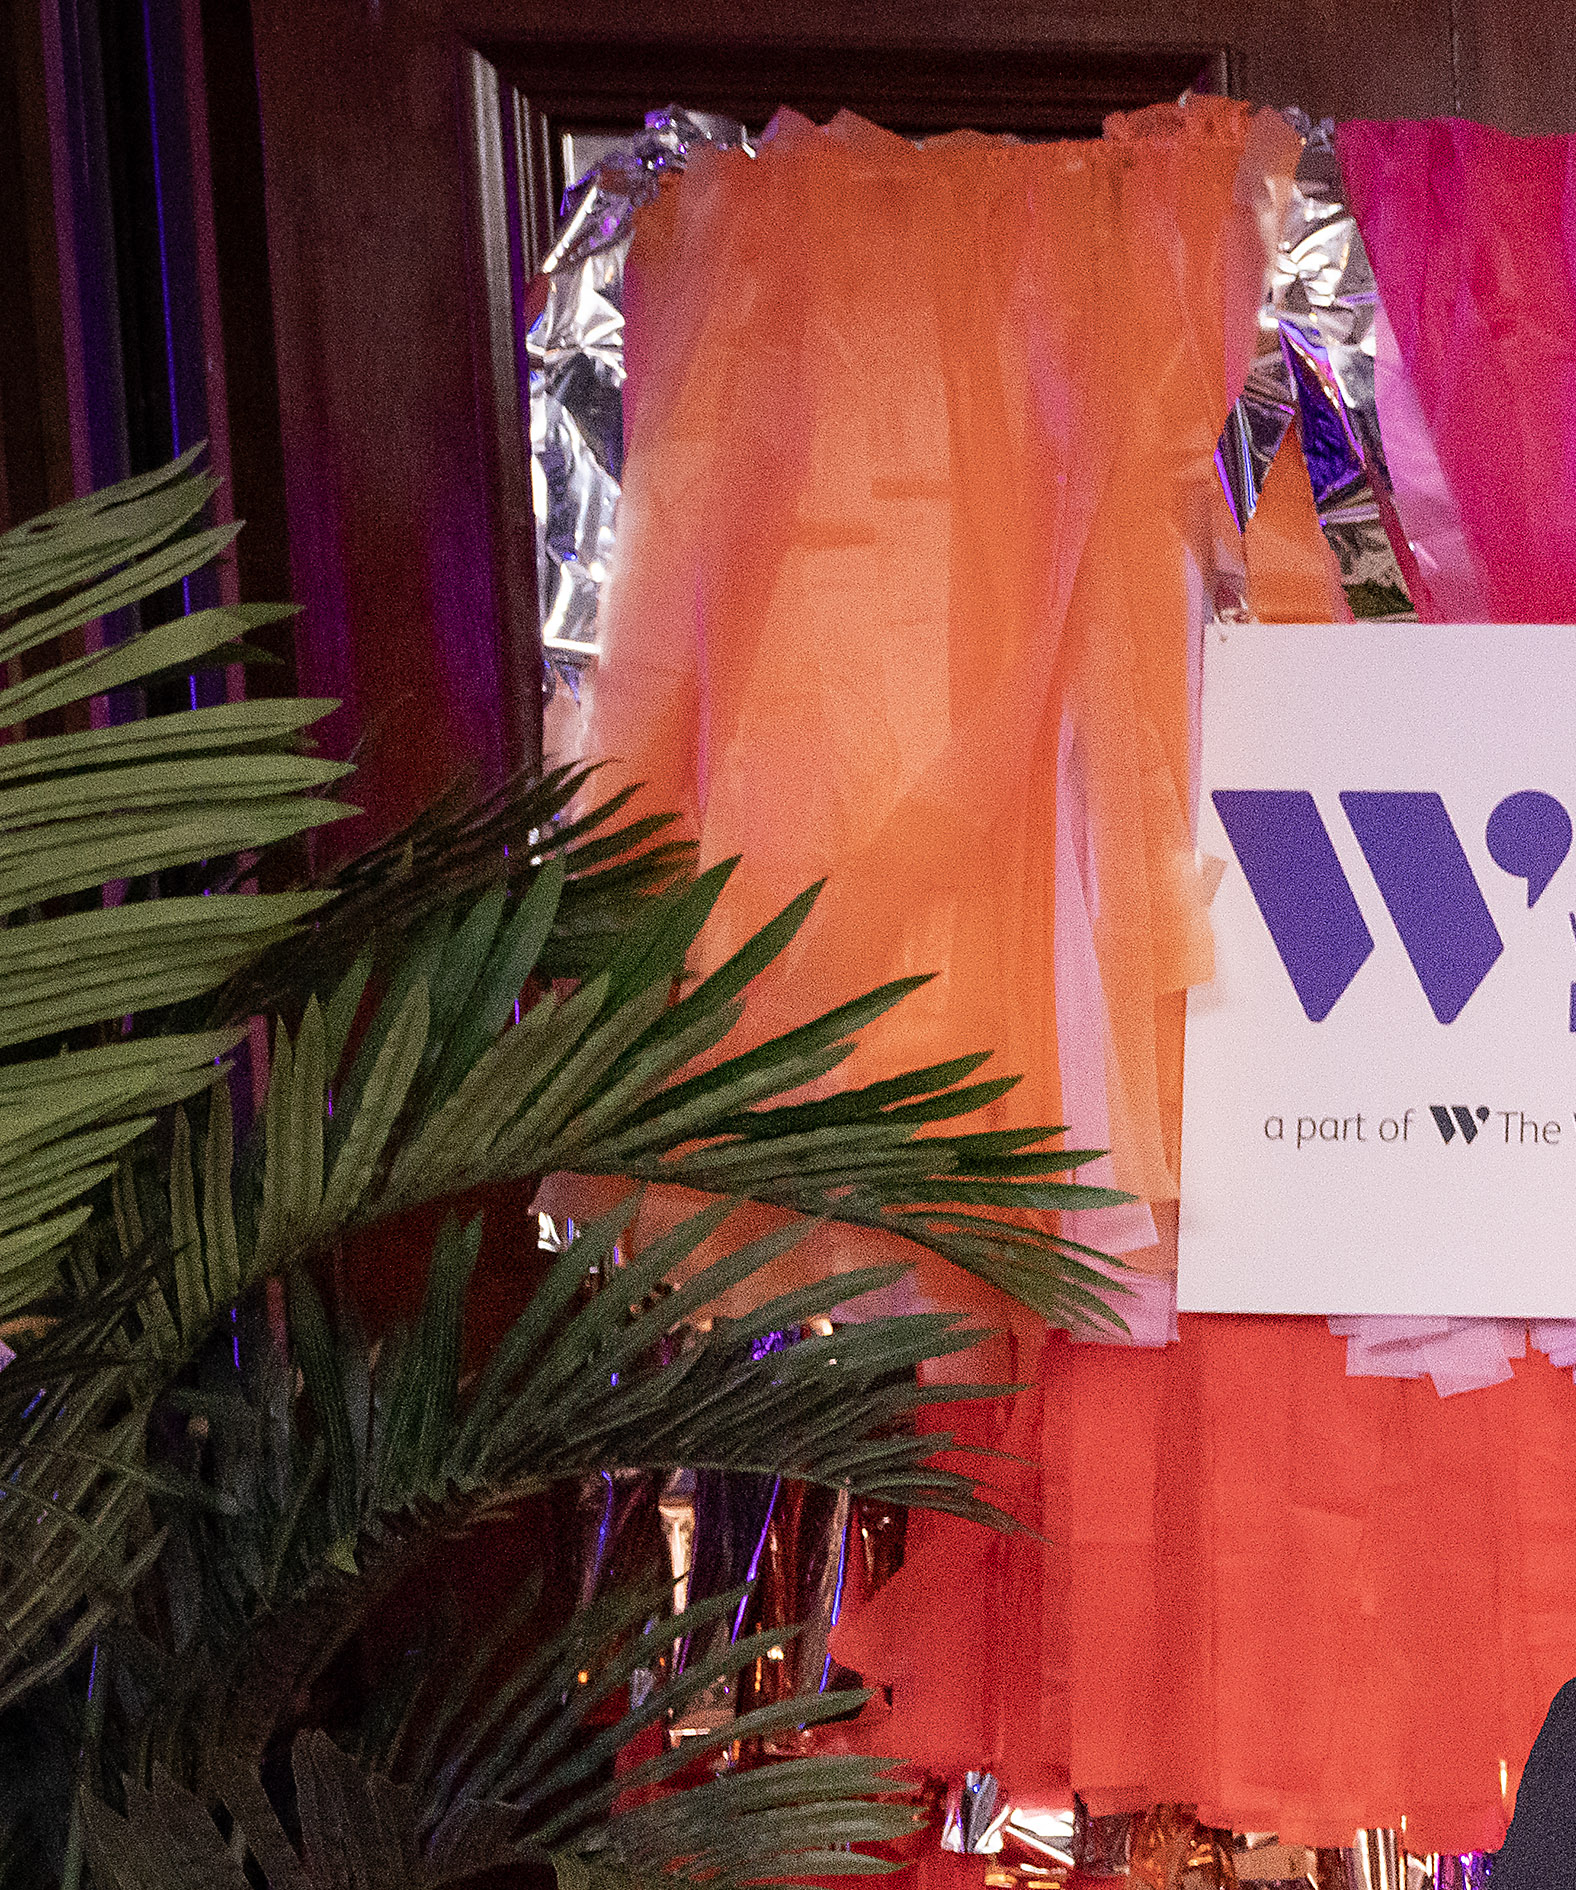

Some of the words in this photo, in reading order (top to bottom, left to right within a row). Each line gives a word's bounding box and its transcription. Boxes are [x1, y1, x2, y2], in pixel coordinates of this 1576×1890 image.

[1264, 1115, 1285, 1141] a
[1296, 1112, 1368, 1151] part
[1378, 1107, 1416, 1143] of
[1497, 1110, 1562, 1145] The
